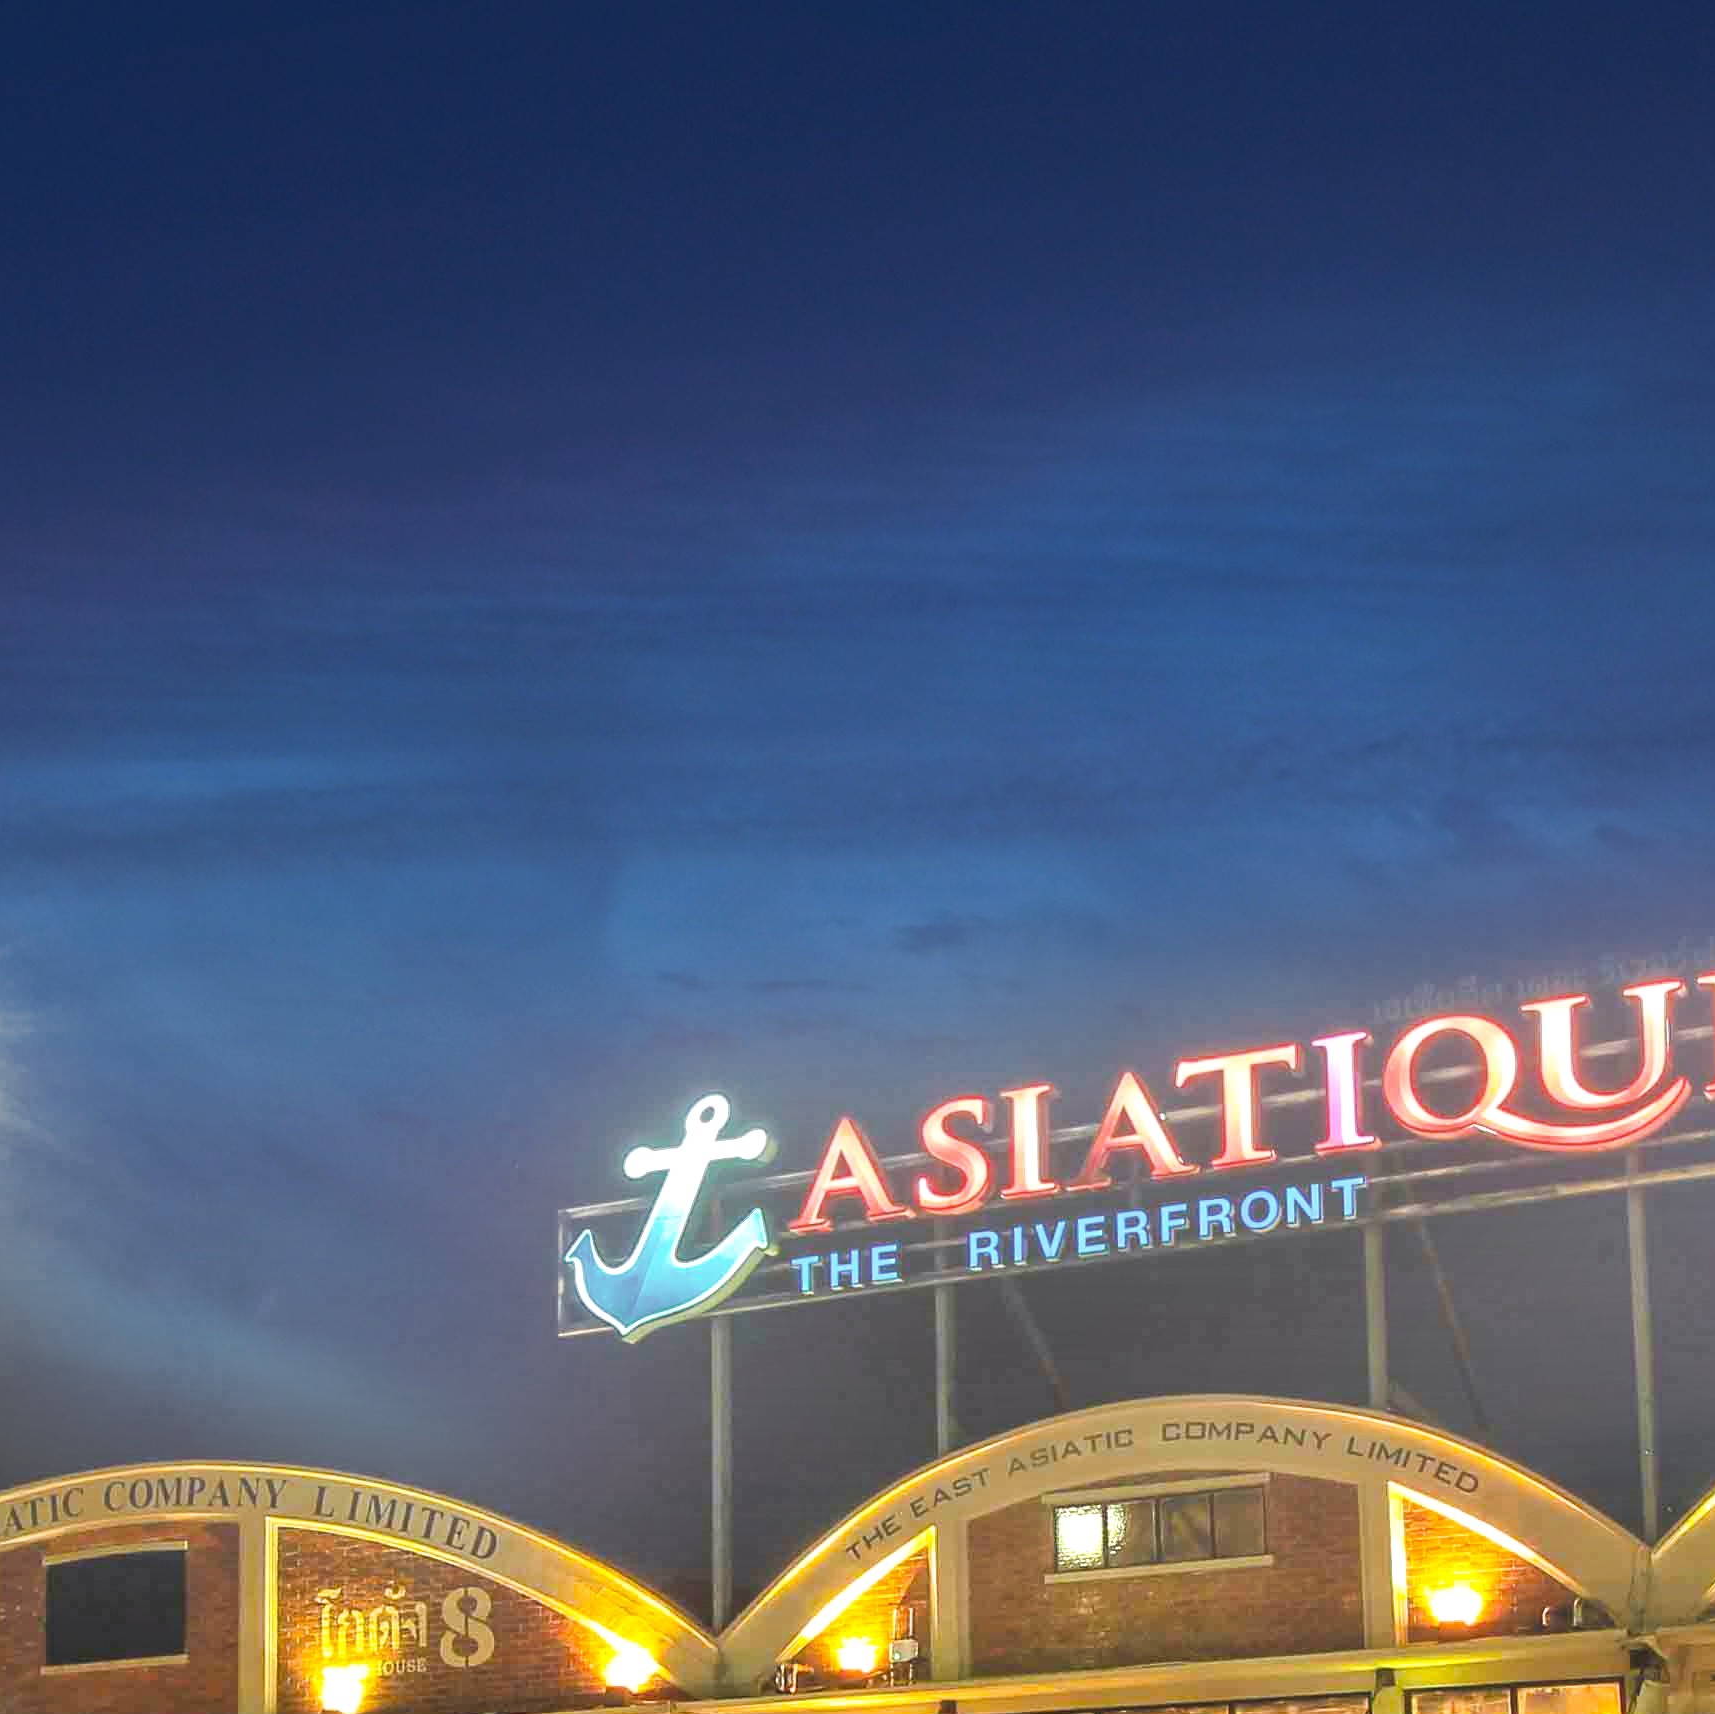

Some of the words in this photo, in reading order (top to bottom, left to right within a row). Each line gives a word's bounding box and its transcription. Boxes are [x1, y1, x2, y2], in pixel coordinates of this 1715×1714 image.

[790, 1244, 904, 1295] THE
[966, 1175, 1369, 1272] RIVERFRONT
[103, 1475, 288, 1513] COMPANY
[313, 1484, 500, 1561] LIMITED
[845, 1512, 903, 1562] THE
[909, 1466, 990, 1519] EAST
[1006, 1428, 1136, 1478] ASIATIC
[1160, 1420, 1334, 1451] COMPANY
[1346, 1434, 1480, 1495] LIMITED
[439, 1586, 496, 1668] 8
